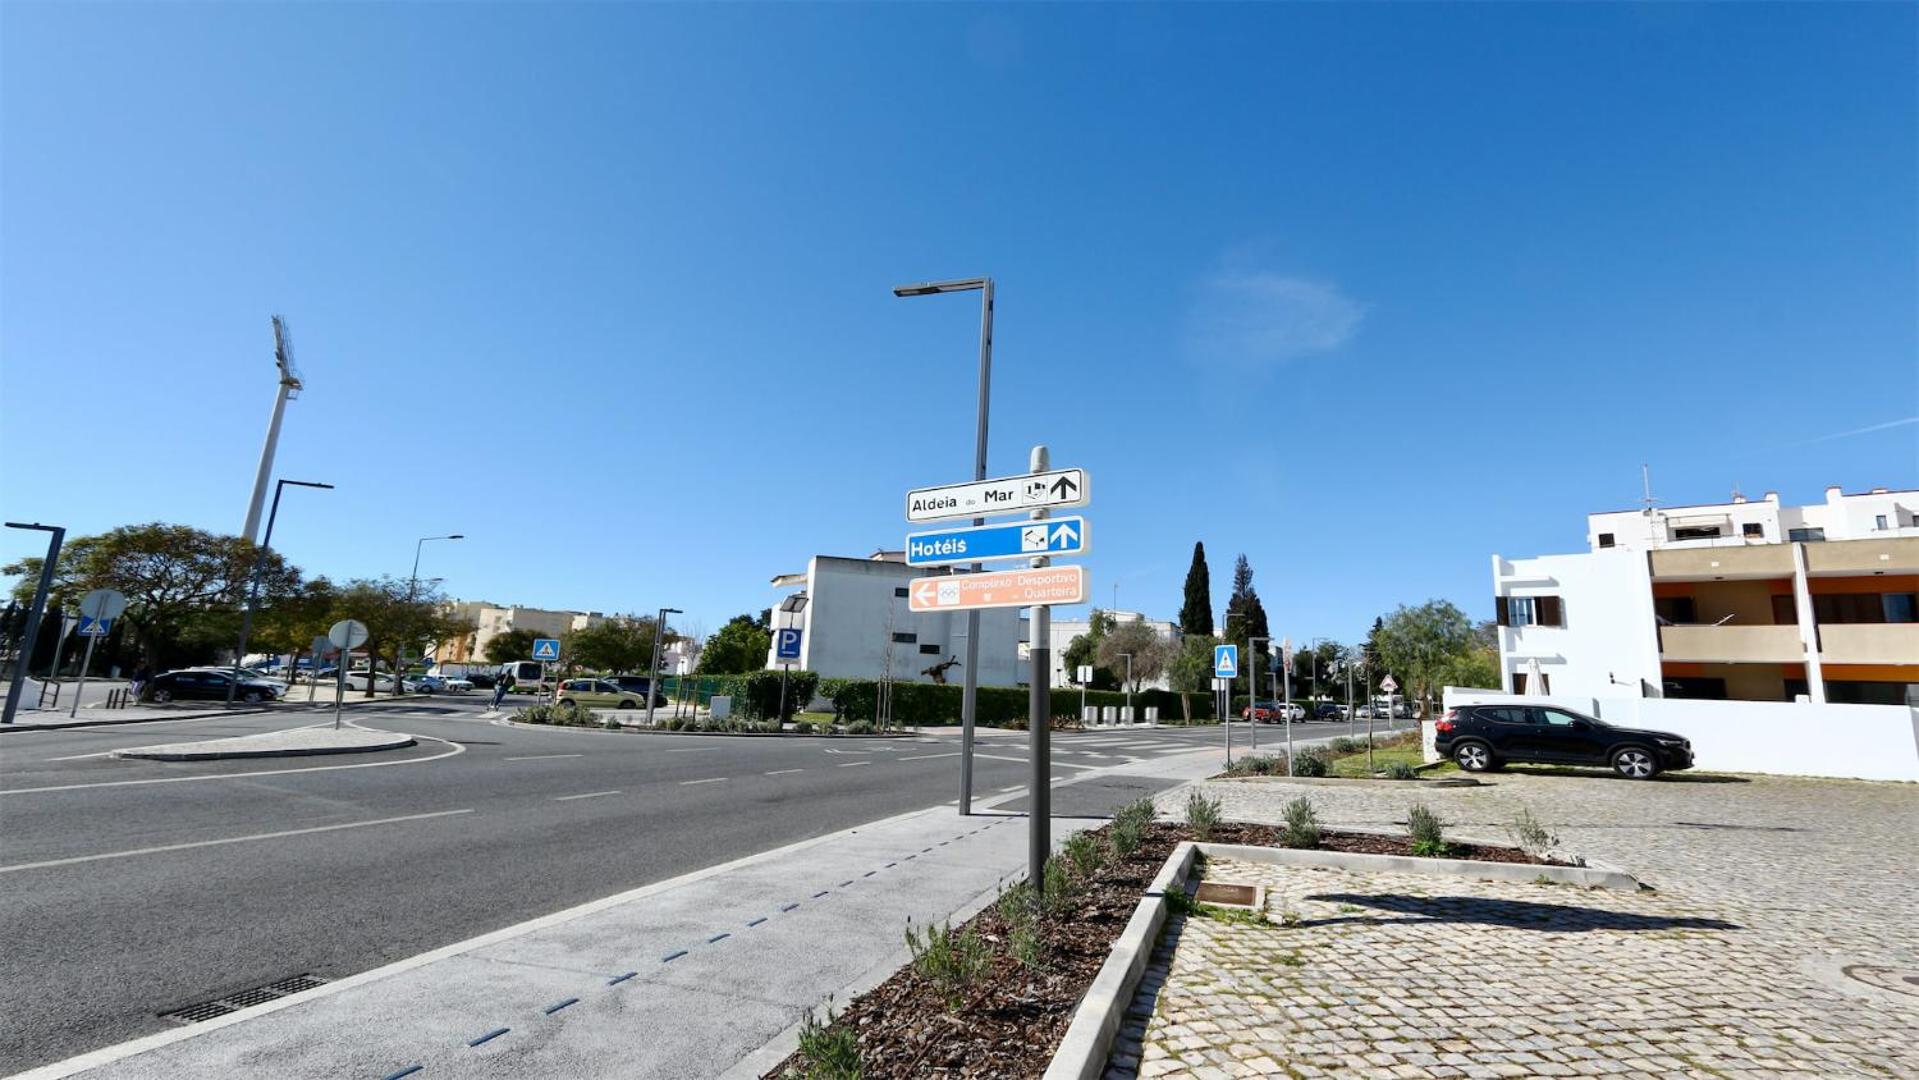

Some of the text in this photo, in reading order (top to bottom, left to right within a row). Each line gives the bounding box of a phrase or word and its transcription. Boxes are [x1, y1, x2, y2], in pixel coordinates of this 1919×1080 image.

[911, 496, 957, 511] Aldeia
[984, 490, 1014, 503] Mar
[911, 538, 967, 557] Hotéis
[1017, 573, 1077, 586] Desportivo
[781, 631, 797, 650] P
